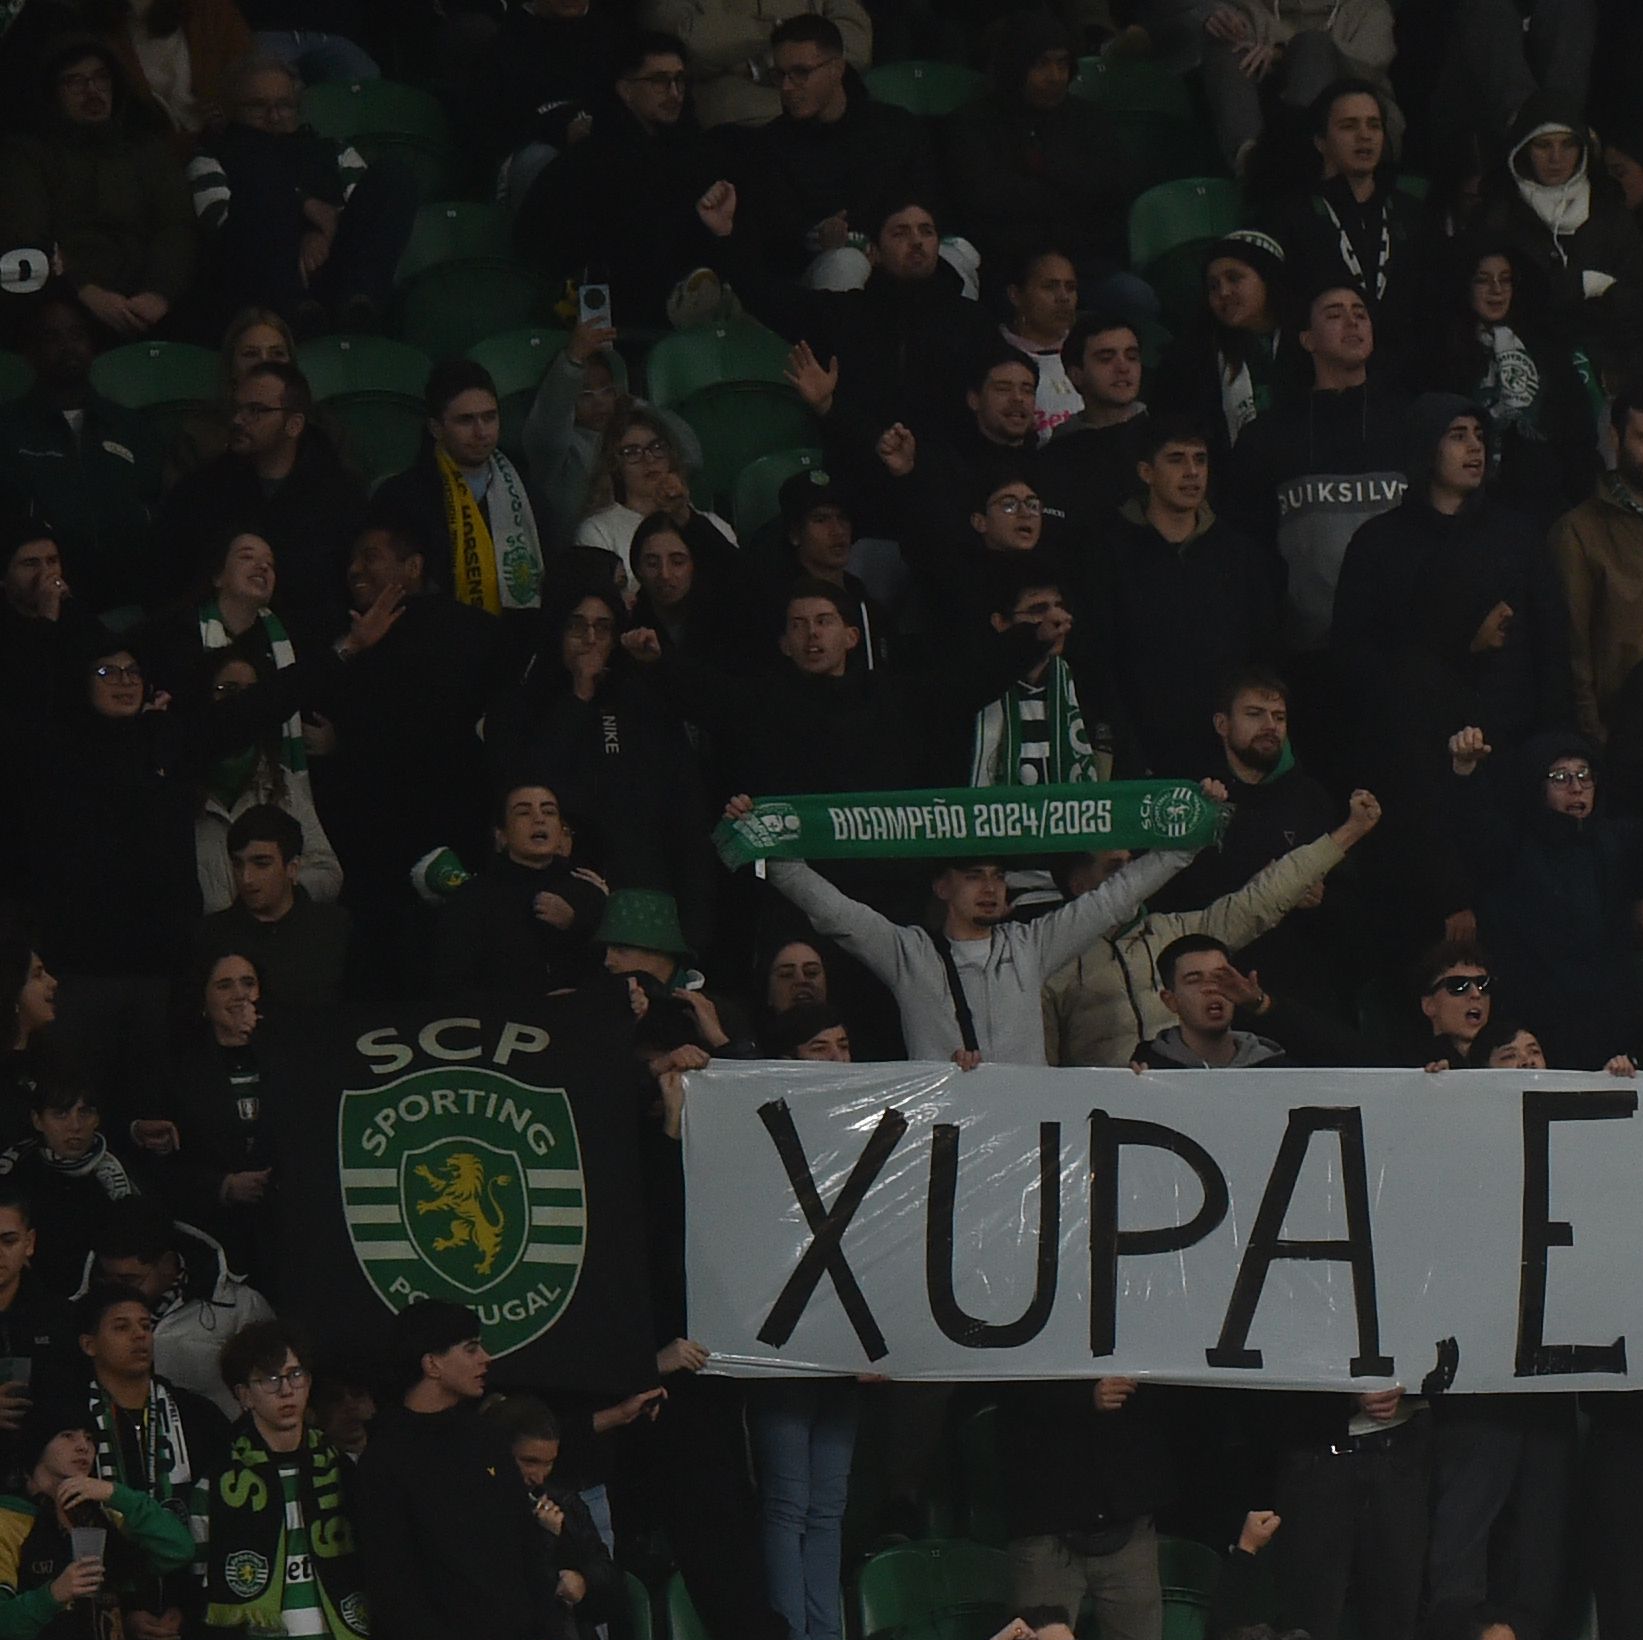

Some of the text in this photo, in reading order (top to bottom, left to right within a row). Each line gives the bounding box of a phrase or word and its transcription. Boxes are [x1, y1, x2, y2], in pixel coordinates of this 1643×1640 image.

[602, 715, 620, 755] NIKE
[828, 798, 968, 841] BICAMPEÃO
[974, 799, 1112, 839] 2024/2025
[356, 1017, 551, 1075] SCP
[361, 1088, 556, 1158] SPORTING
[755, 1095, 1461, 1394] XUPA,
[388, 1275, 562, 1326] POUGAL
